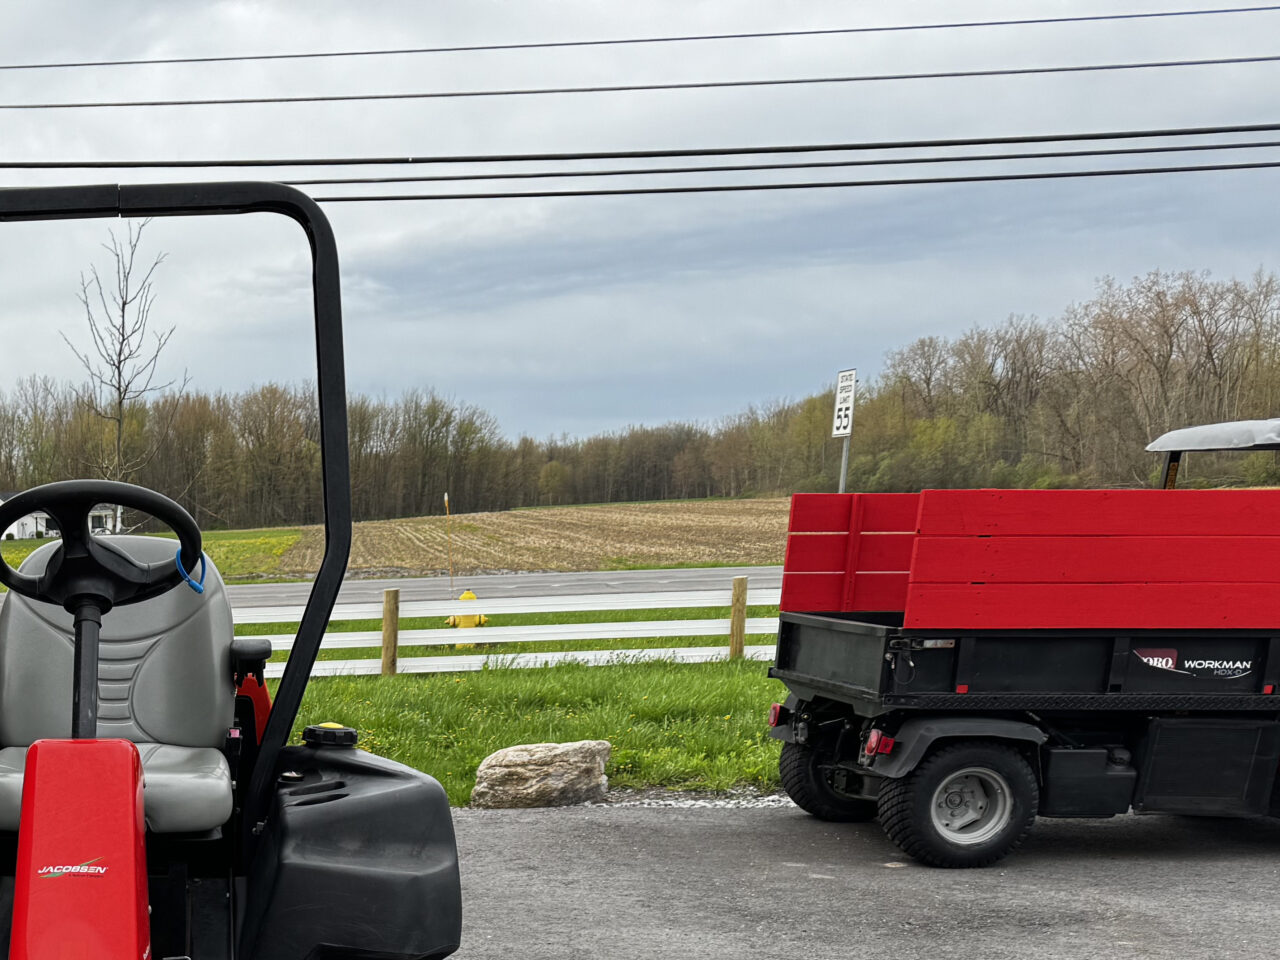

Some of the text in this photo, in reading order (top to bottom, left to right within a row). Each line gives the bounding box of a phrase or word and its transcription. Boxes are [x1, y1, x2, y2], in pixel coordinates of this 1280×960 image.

[839, 385, 852, 393] SPEED
[839, 395, 850, 404] LIMIT
[836, 407, 850, 430] 55
[1184, 660, 1251, 668] WORKMAN
[38, 865, 106, 874] JACOBSEN
